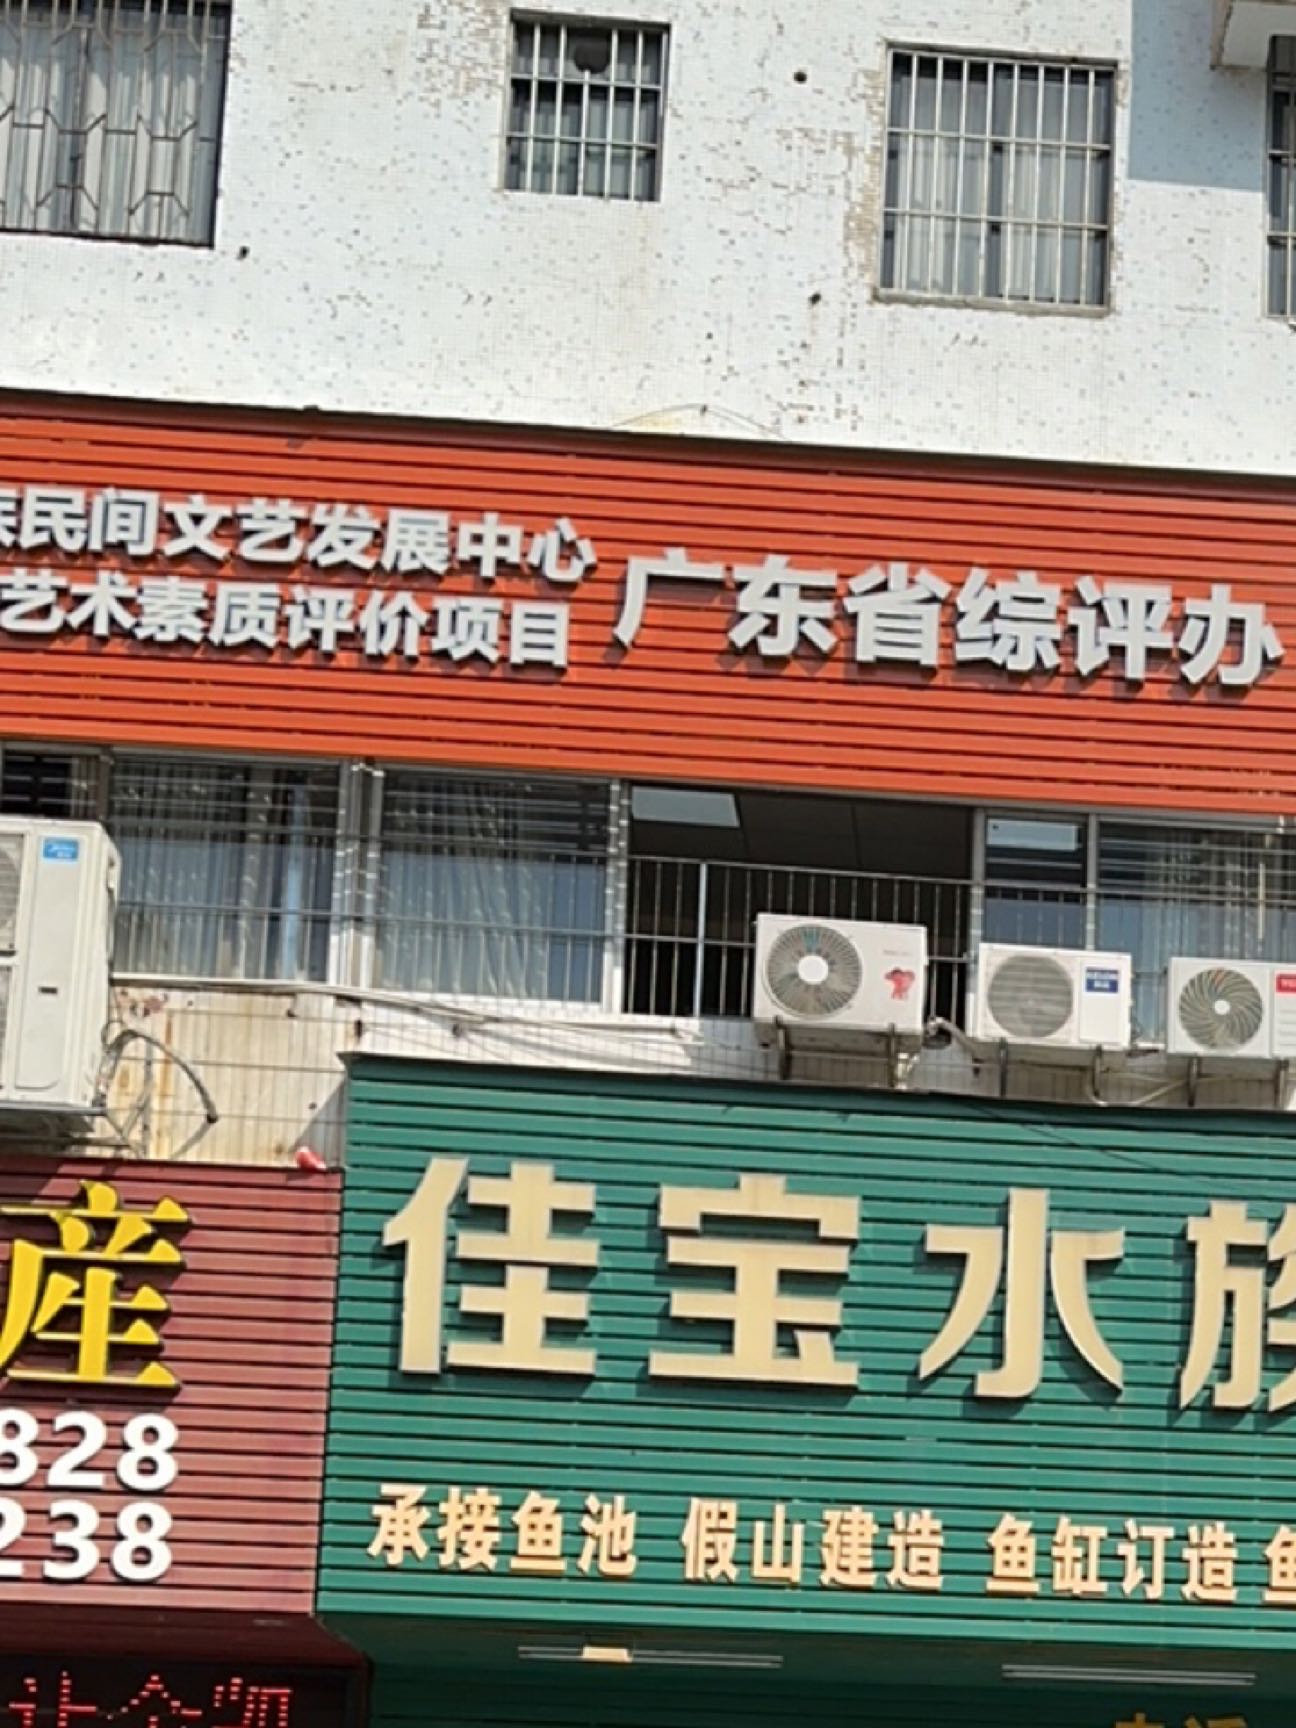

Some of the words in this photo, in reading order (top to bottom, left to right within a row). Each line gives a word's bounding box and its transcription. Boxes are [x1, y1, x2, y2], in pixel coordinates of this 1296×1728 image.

[0, 485, 596, 584] 民间文艺发展中心
[0, 568, 570, 669] 艺术素质评价项目
[613, 546, 1284, 687] 广东省综评办
[0, 1408, 179, 1492] 828
[367, 1483, 636, 1578] 承接鱼池
[682, 1496, 946, 1591] 假山建造
